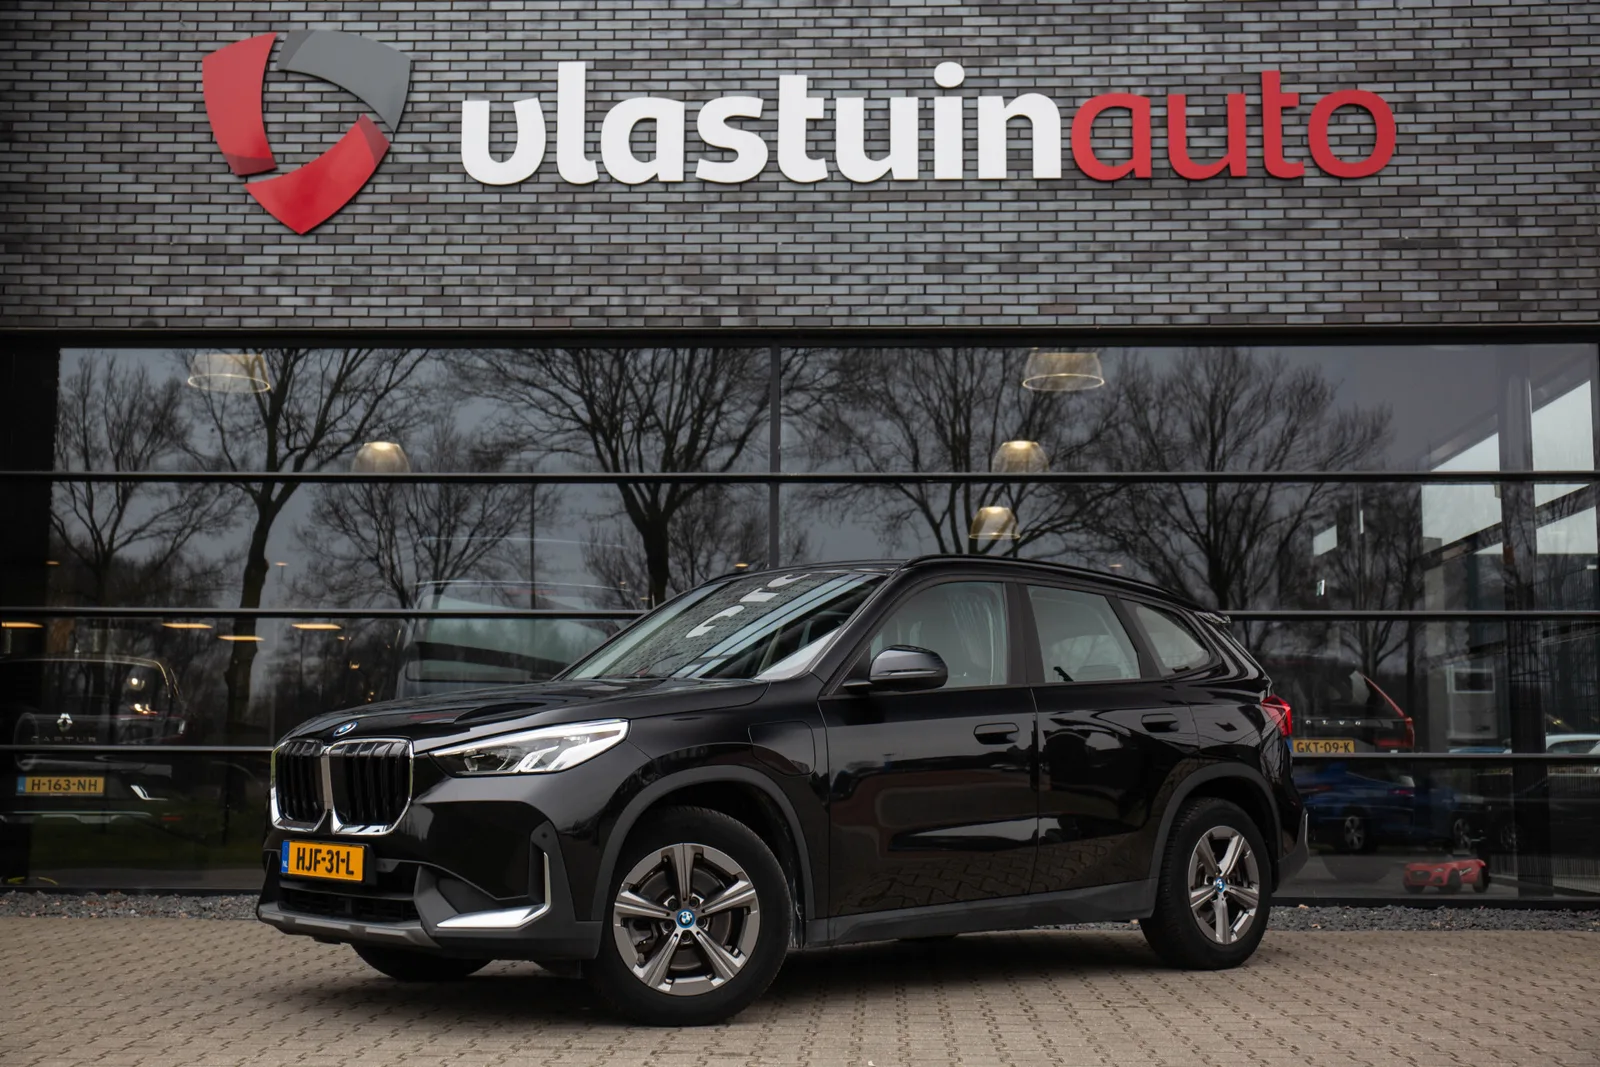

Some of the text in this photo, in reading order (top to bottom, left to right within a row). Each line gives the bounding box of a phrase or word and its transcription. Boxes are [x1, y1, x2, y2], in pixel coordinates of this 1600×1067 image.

[1296, 741, 1352, 754] GKT-09-K
[31, 779, 98, 791] H-163-NH
[296, 846, 355, 876] HJF-31-L
